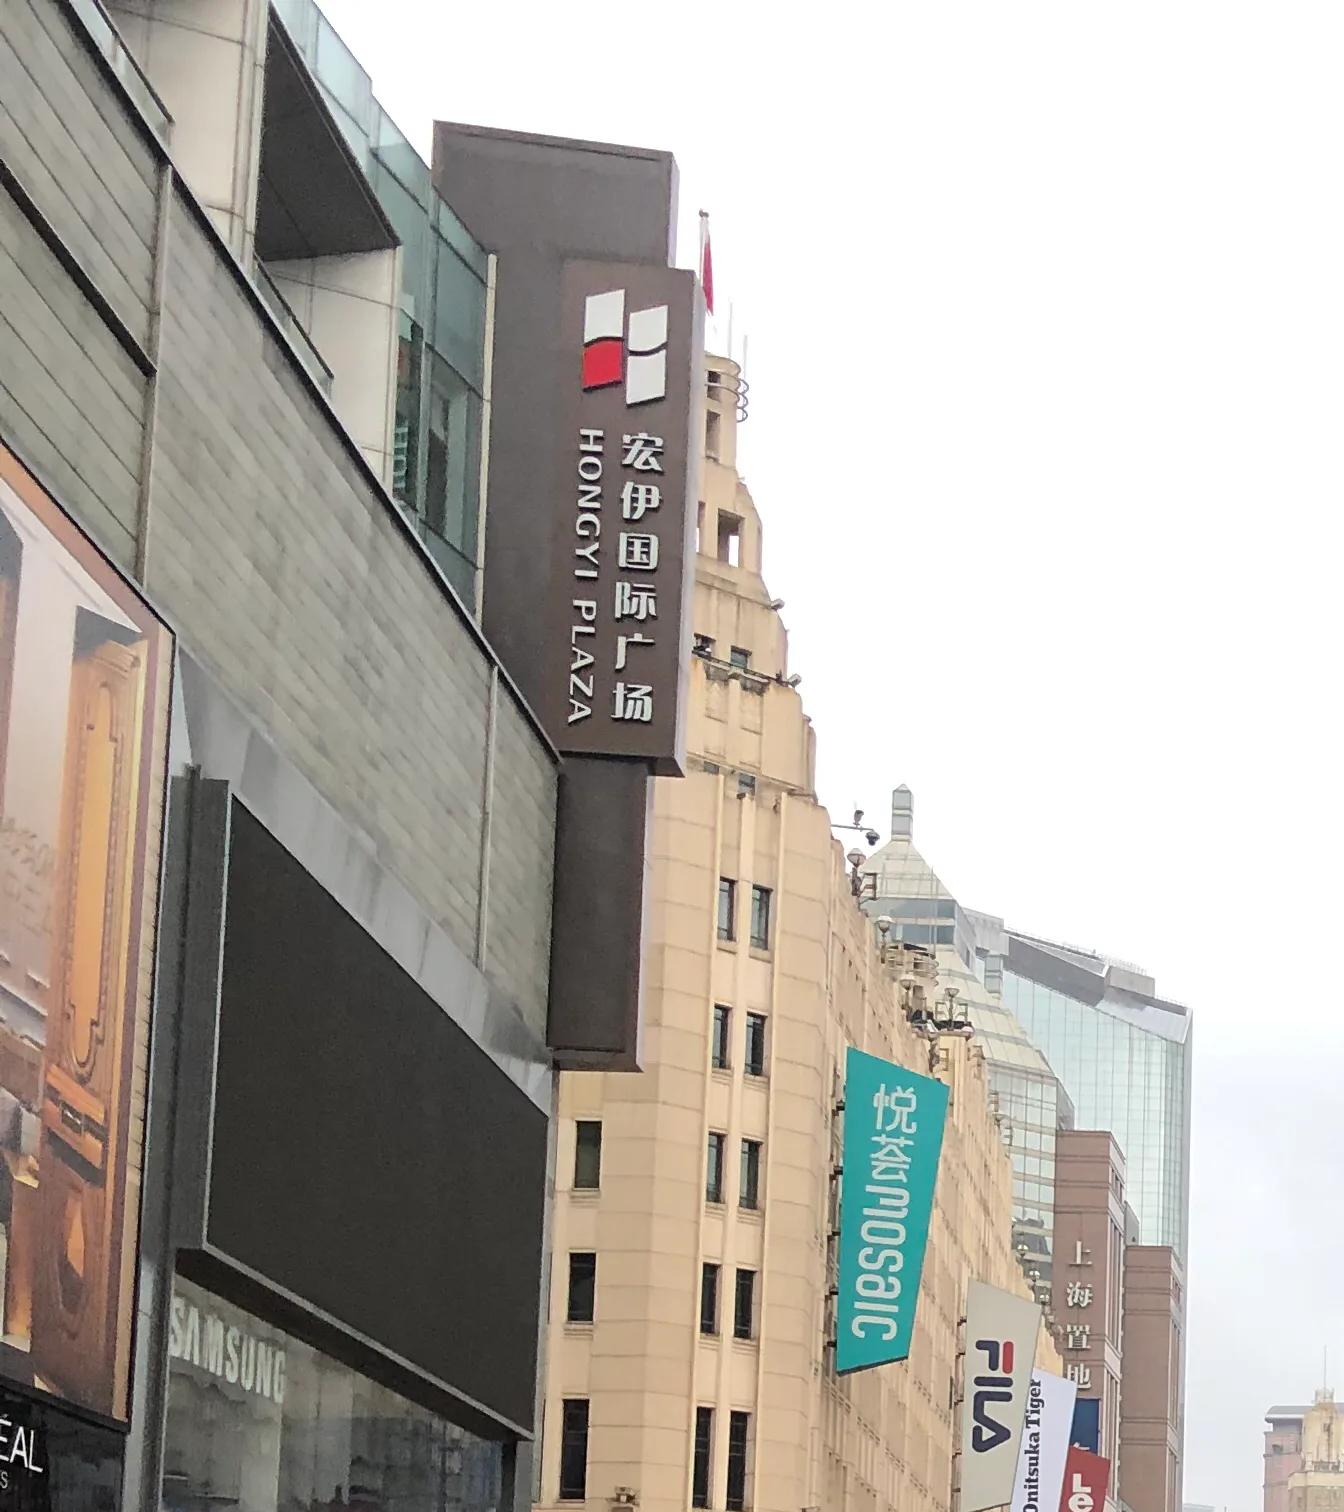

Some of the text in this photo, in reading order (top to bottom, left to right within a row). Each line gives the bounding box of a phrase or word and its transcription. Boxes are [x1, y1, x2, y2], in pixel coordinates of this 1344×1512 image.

[566, 427, 604, 724] HONGYI PLAZA
[611, 431, 664, 724] 宏伊国际广场
[870, 1083, 917, 1184] 悦荟
[168, 1296, 286, 1404] SAMSUNG
[1066, 1240, 1093, 1390] 上海置地
[972, 1339, 1014, 1453] FILA
[1025, 1378, 1045, 1430] Tiger
